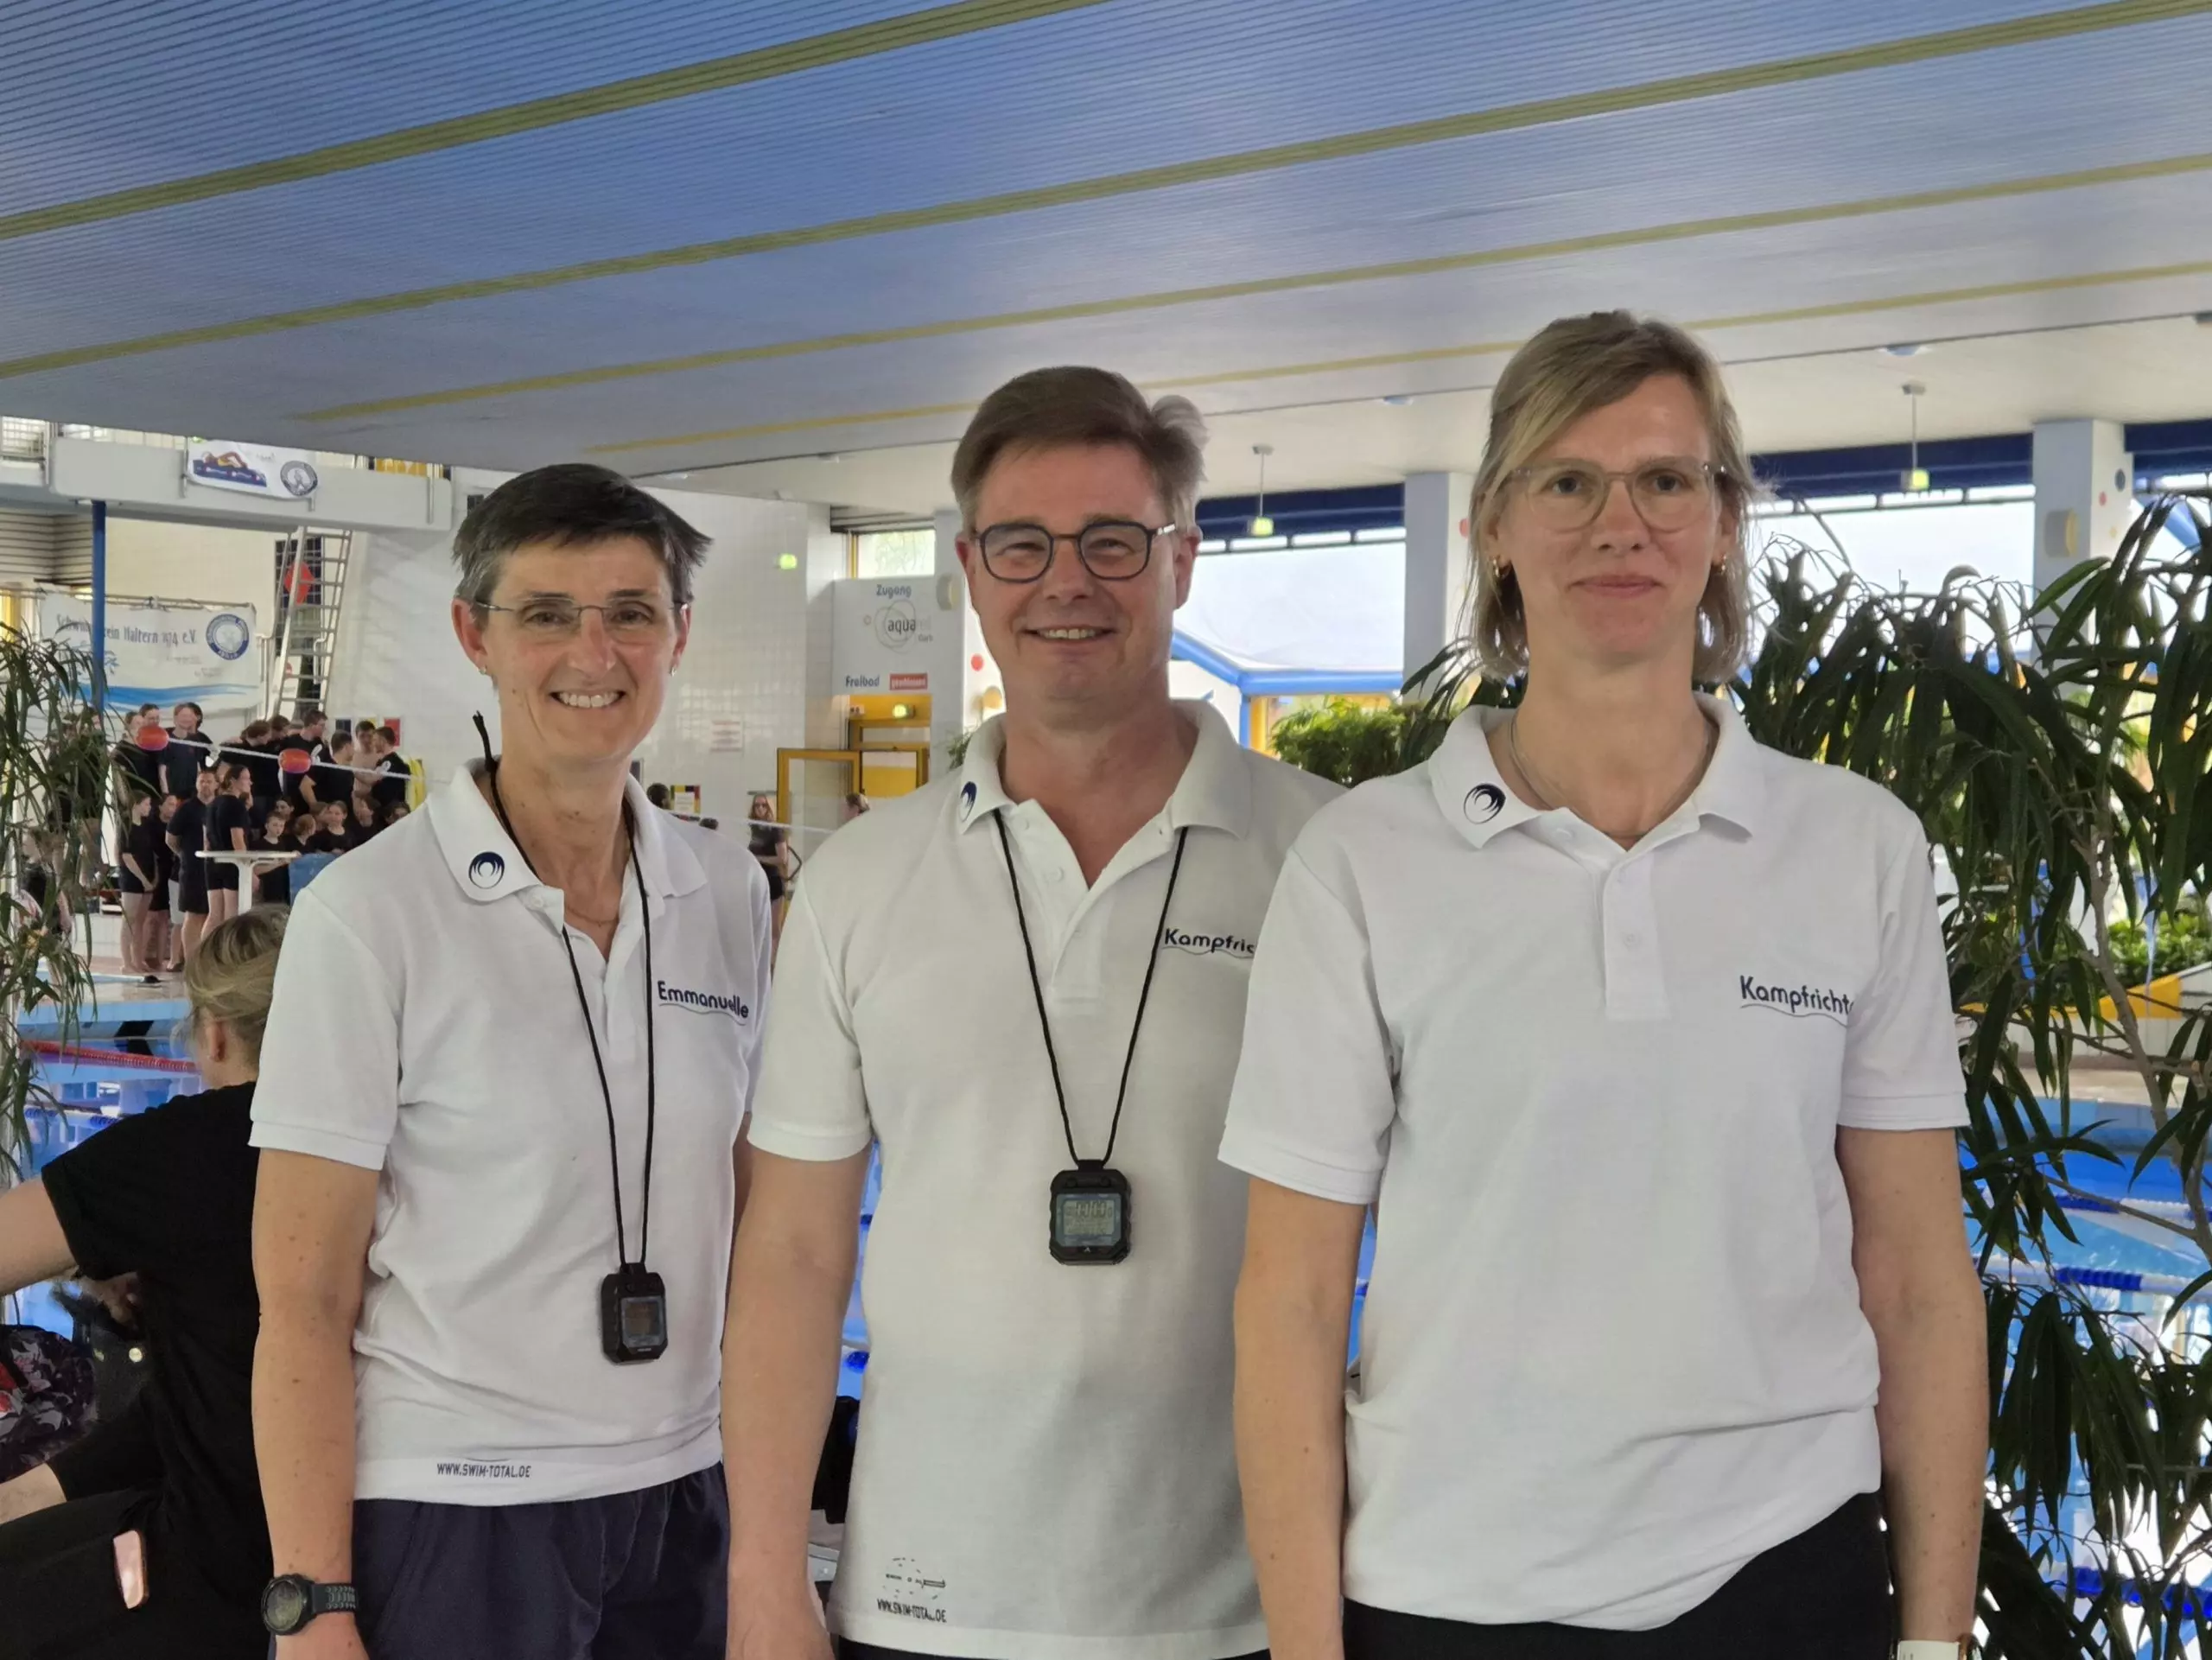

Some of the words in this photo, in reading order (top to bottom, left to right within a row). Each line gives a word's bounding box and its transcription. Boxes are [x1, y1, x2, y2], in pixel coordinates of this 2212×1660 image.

[876, 584, 912, 599] Zugang
[845, 675, 880, 688] Freibad
[657, 980, 749, 1018] Emmanuelle
